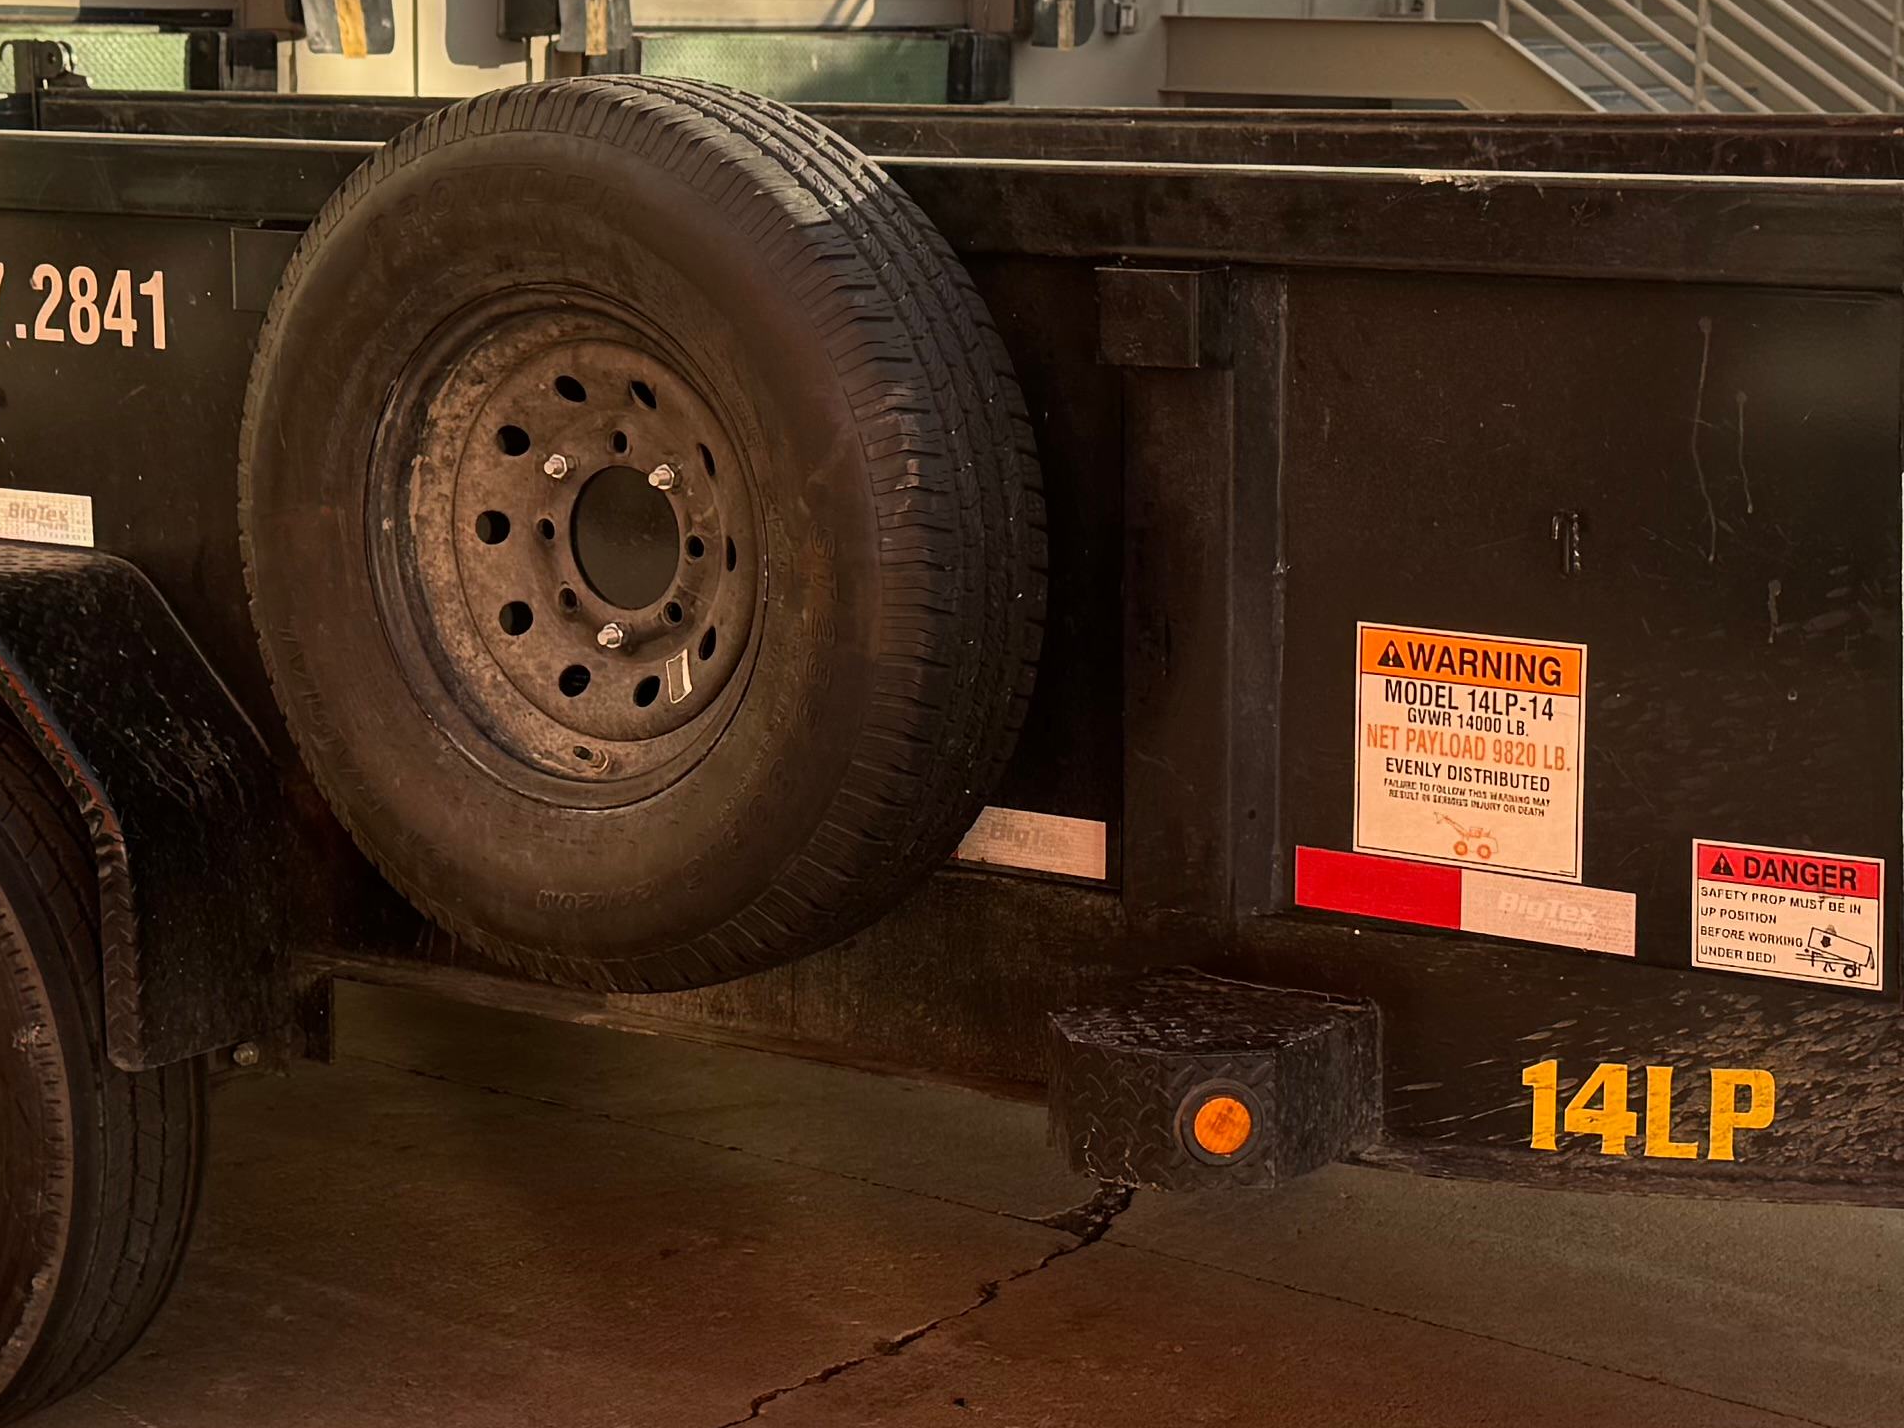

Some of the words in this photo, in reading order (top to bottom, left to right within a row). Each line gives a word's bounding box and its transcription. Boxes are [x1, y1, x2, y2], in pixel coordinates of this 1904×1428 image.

[7, 502, 68, 523] BigTex
[1407, 641, 1561, 687] WARNING
[1385, 679, 1459, 710] MODEL
[1468, 689, 1553, 721] 14LP-14
[1407, 707, 1451, 727] GVWR
[1457, 714, 1502, 733] 14000
[1507, 719, 1529, 737] LB.
[1366, 723, 1399, 750] NET
[1405, 728, 1486, 761] PAYLOAD
[1493, 739, 1536, 767] 9820
[1543, 745, 1571, 772] LB.
[1385, 757, 1442, 778] EVENLY
[1448, 765, 1550, 792] DISTRIBUTED
[1384, 777, 1417, 790] FAILURE
[1419, 782, 1430, 792] TO
[1432, 784, 1466, 797] FOLLOW
[1468, 788, 1487, 800] THIS
[1490, 791, 1530, 805] WARNING
[1532, 797, 1550, 808] MAY
[1388, 789, 1419, 801] RESULT
[1421, 793, 1431, 803] IN
[1471, 798, 1502, 811] INJURY
[1503, 803, 1516, 813] OR
[1517, 806, 1545, 817] DEATH
[1743, 856, 1857, 891] DANGER
[1497, 891, 1598, 924] BigTex
[1700, 886, 1747, 901] SAFETY
[1751, 893, 1786, 905] PROP
[1790, 897, 1824, 911] MUST
[1829, 902, 1845, 913] BE
[1849, 904, 1862, 915] IN
[1700, 906, 1716, 916] UP
[1720, 908, 1777, 924] POSITION
[1700, 926, 1745, 941] BEFORE
[1748, 931, 1803, 947] WORKING
[1700, 945, 1743, 960] UNDER
[1746, 951, 1776, 964] BED!
[1521, 1058, 1776, 1162] 14LP
